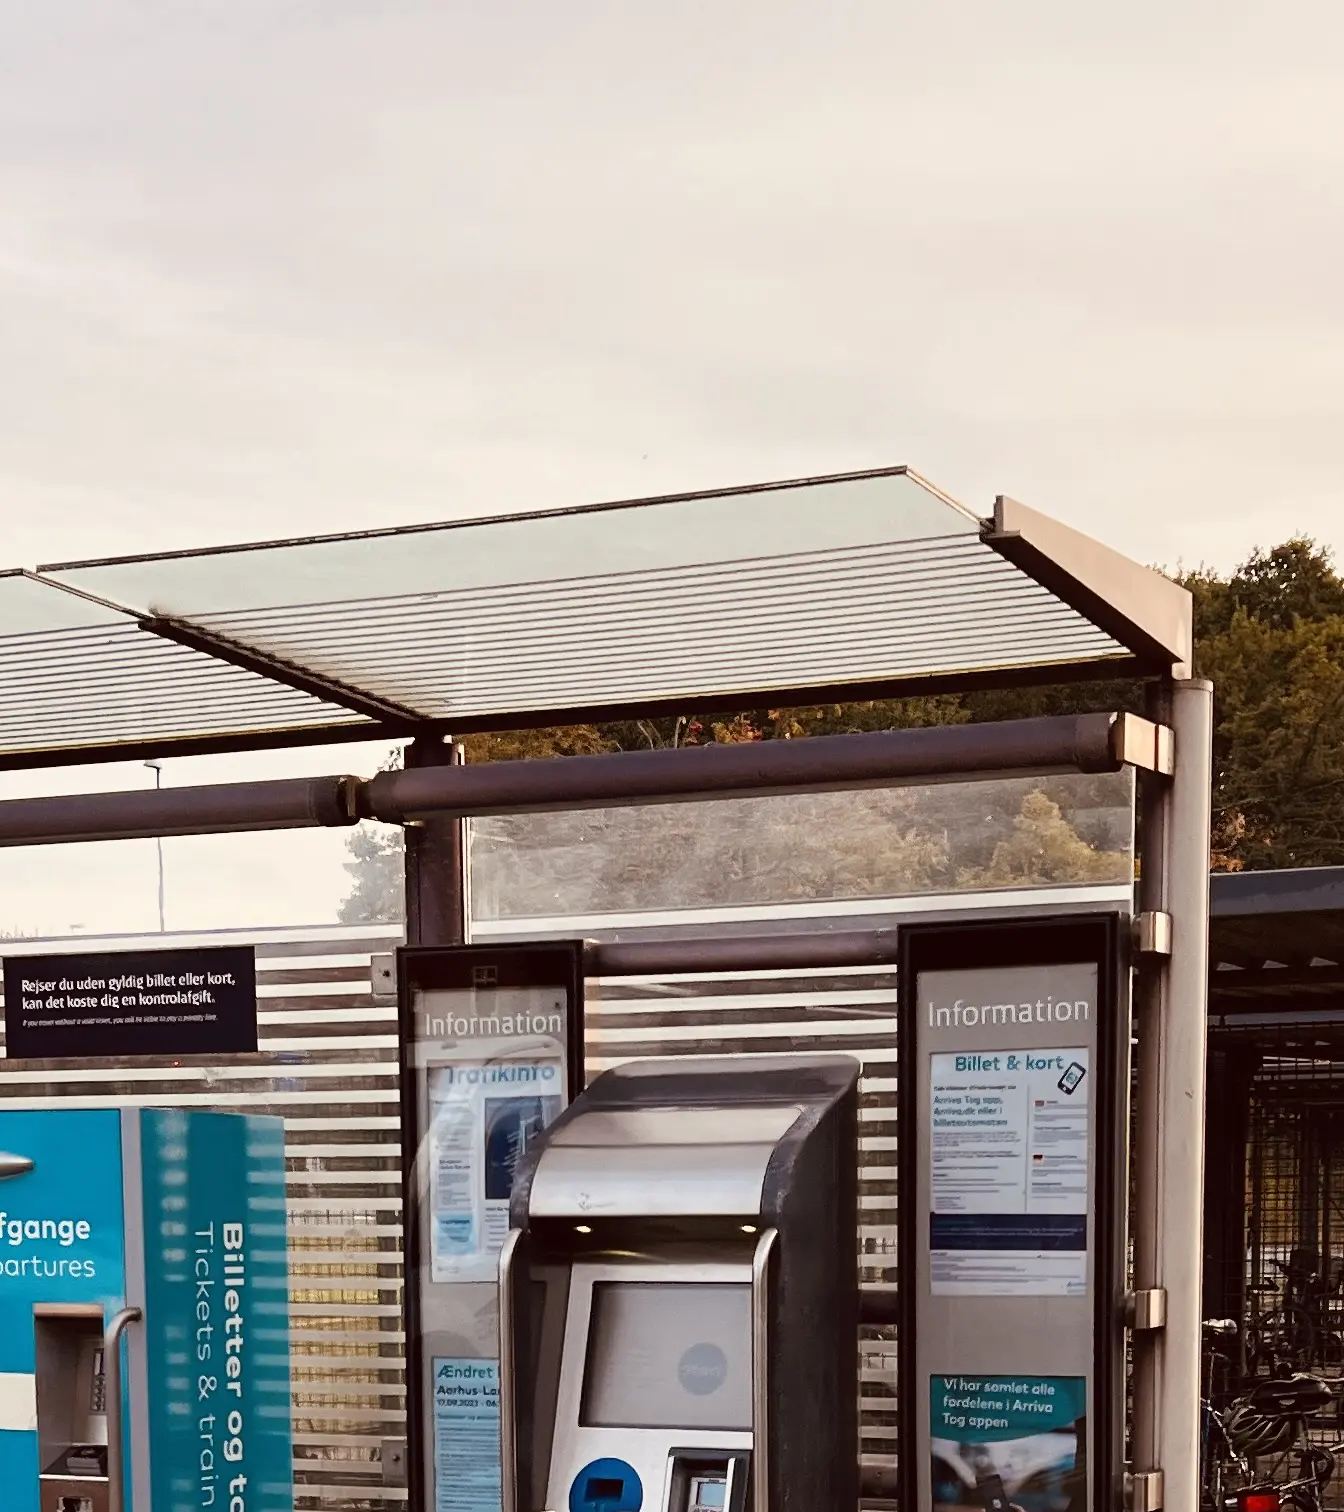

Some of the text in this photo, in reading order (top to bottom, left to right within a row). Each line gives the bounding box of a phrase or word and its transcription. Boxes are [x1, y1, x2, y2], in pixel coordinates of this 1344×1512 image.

[21, 971, 236, 995] Rejser du uden gyldig billet eller kort,
[22, 989, 217, 1010] kan det koste dig en kontrolafgift.
[928, 995, 1089, 1027] Information
[425, 1010, 561, 1036] Information
[955, 1054, 1065, 1072] Billet & kort
[194, 1220, 215, 1361] Tickets
[222, 1222, 245, 1398] Billetter
[437, 1364, 493, 1379] Ændret
[198, 1374, 218, 1401] &
[943, 1377, 1056, 1396] Vi har samlet alle
[943, 1394, 1004, 1410] fordelene
[1012, 1399, 1053, 1413] Arriva
[942, 1412, 1008, 1430] Tog appen
[223, 1410, 245, 1462] og
[198, 1415, 219, 1506] train
